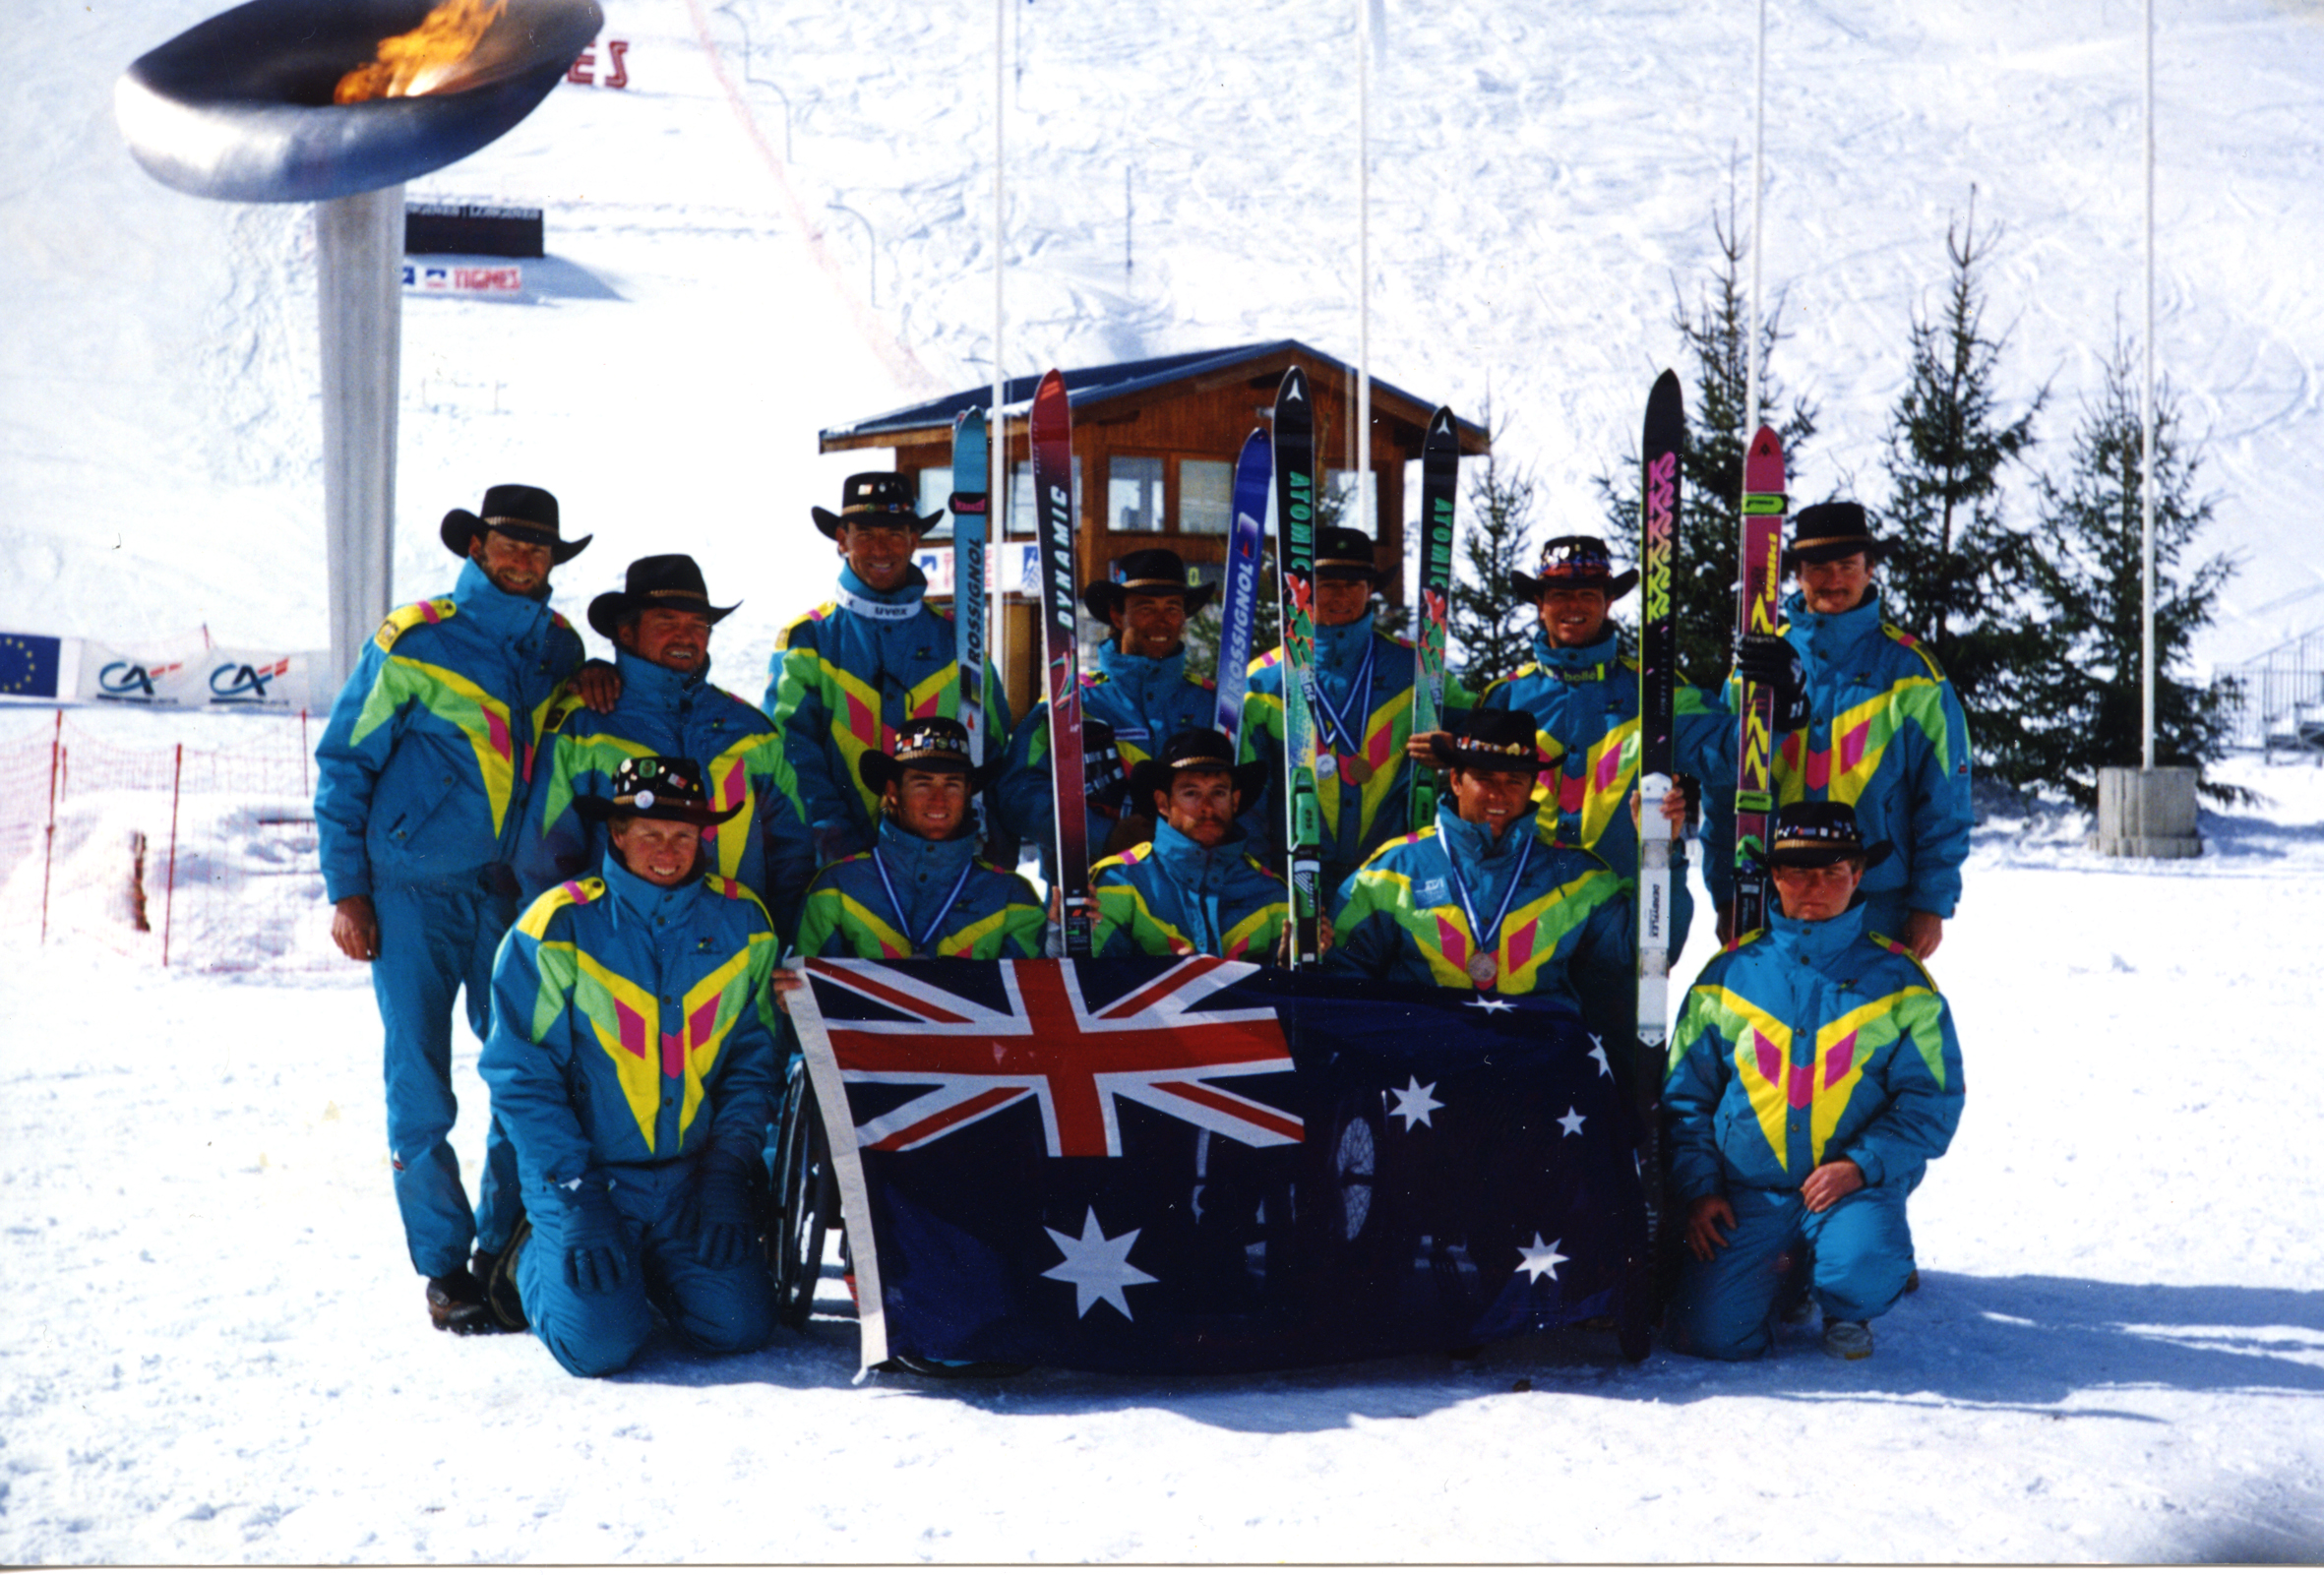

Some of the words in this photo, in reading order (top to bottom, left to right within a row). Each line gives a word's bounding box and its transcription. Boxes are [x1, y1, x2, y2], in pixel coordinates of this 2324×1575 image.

[1050, 485, 1074, 631] DYNAMIC
[1290, 470, 1313, 573] ATOMIC
[1430, 497, 1454, 589] ATOMIC
[875, 606, 907, 616] uvex
[966, 538, 982, 666] ROSSIGNOL
[1228, 562, 1254, 704] ROSSIGNOL
[1652, 883, 1661, 939] DERBYFLEX
